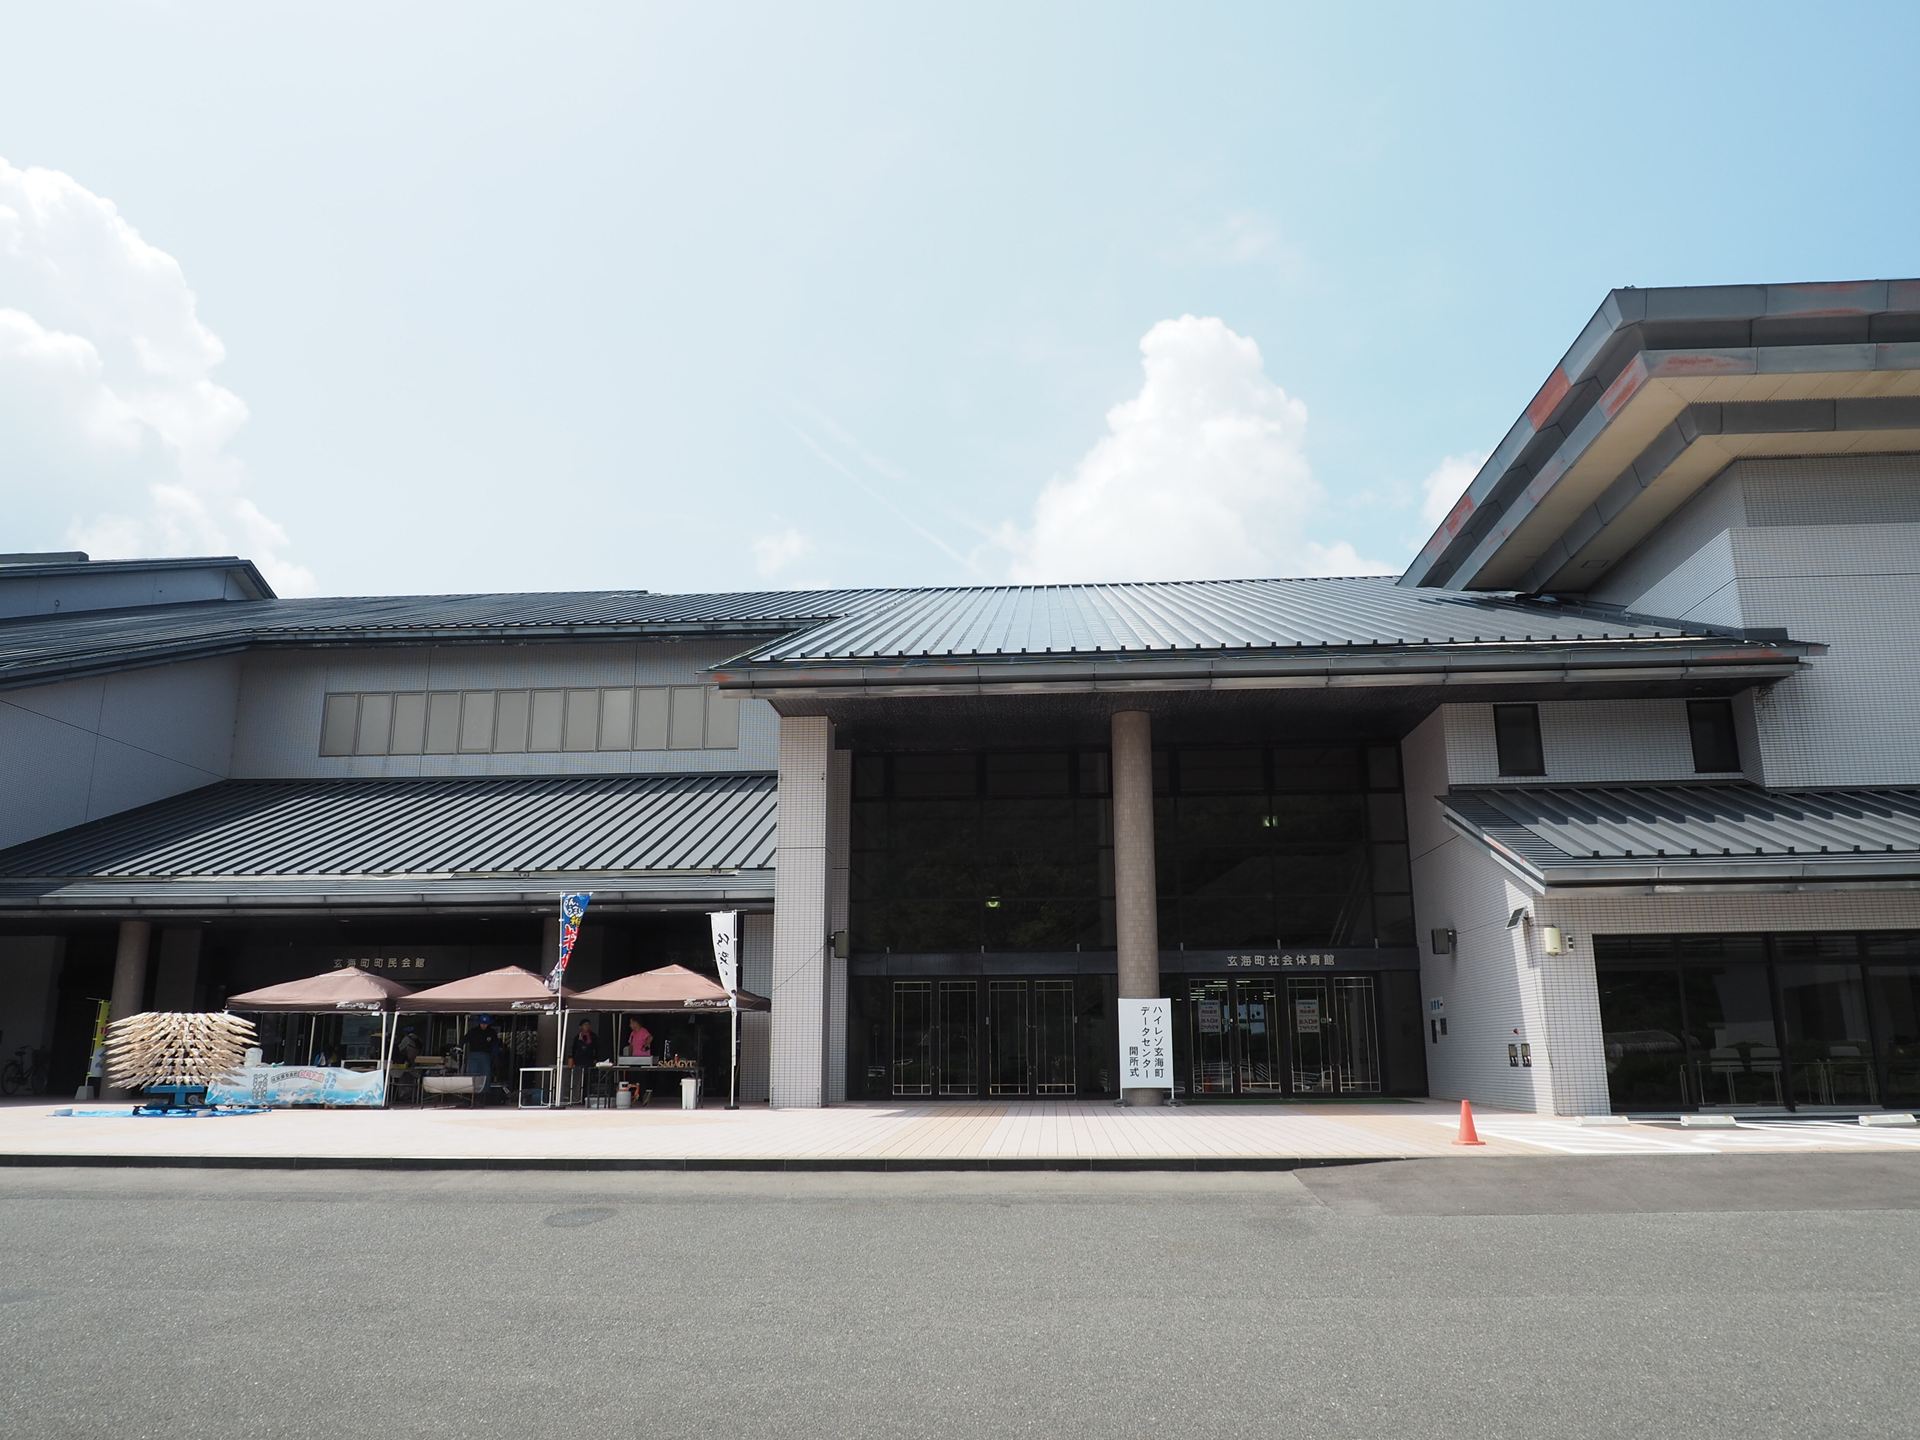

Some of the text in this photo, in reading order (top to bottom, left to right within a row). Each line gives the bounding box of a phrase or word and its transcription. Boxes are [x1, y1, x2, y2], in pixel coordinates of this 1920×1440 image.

[333, 957, 425, 969] 玄海町町民会館
[1227, 954, 1335, 967] 玄海町社会体育館
[1140, 1006, 1151, 1079] データセンター
[1153, 1006, 1164, 1079] ハイレゾ玄海町
[1129, 1046, 1140, 1077] 開所式
